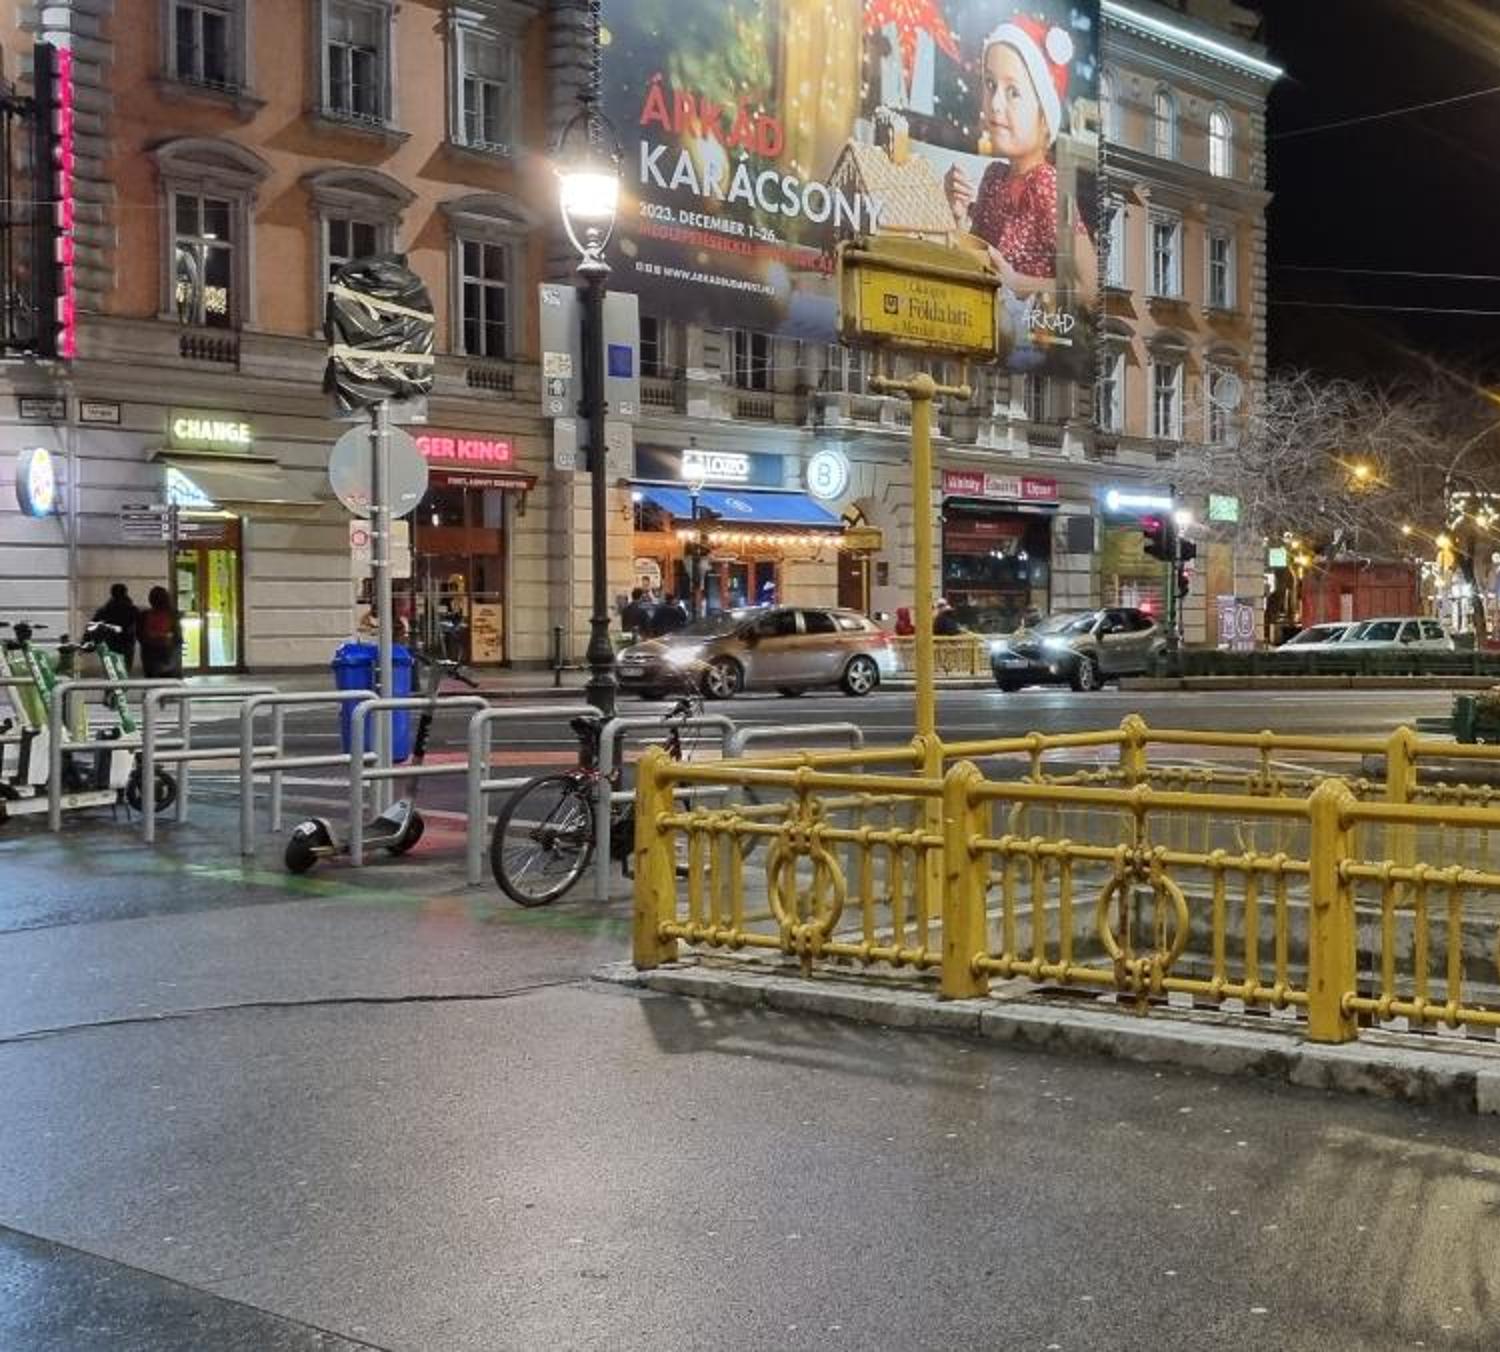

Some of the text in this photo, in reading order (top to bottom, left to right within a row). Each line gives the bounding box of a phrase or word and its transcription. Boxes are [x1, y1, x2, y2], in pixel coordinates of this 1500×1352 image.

[640, 72, 784, 158] ÁRKÁD
[640, 140, 884, 235] KARÁCSONY
[639, 202, 675, 222] 2023.
[679, 208, 745, 234] DECEMBER
[173, 418, 251, 443] CHANGE
[415, 436, 509, 461] GER KING
